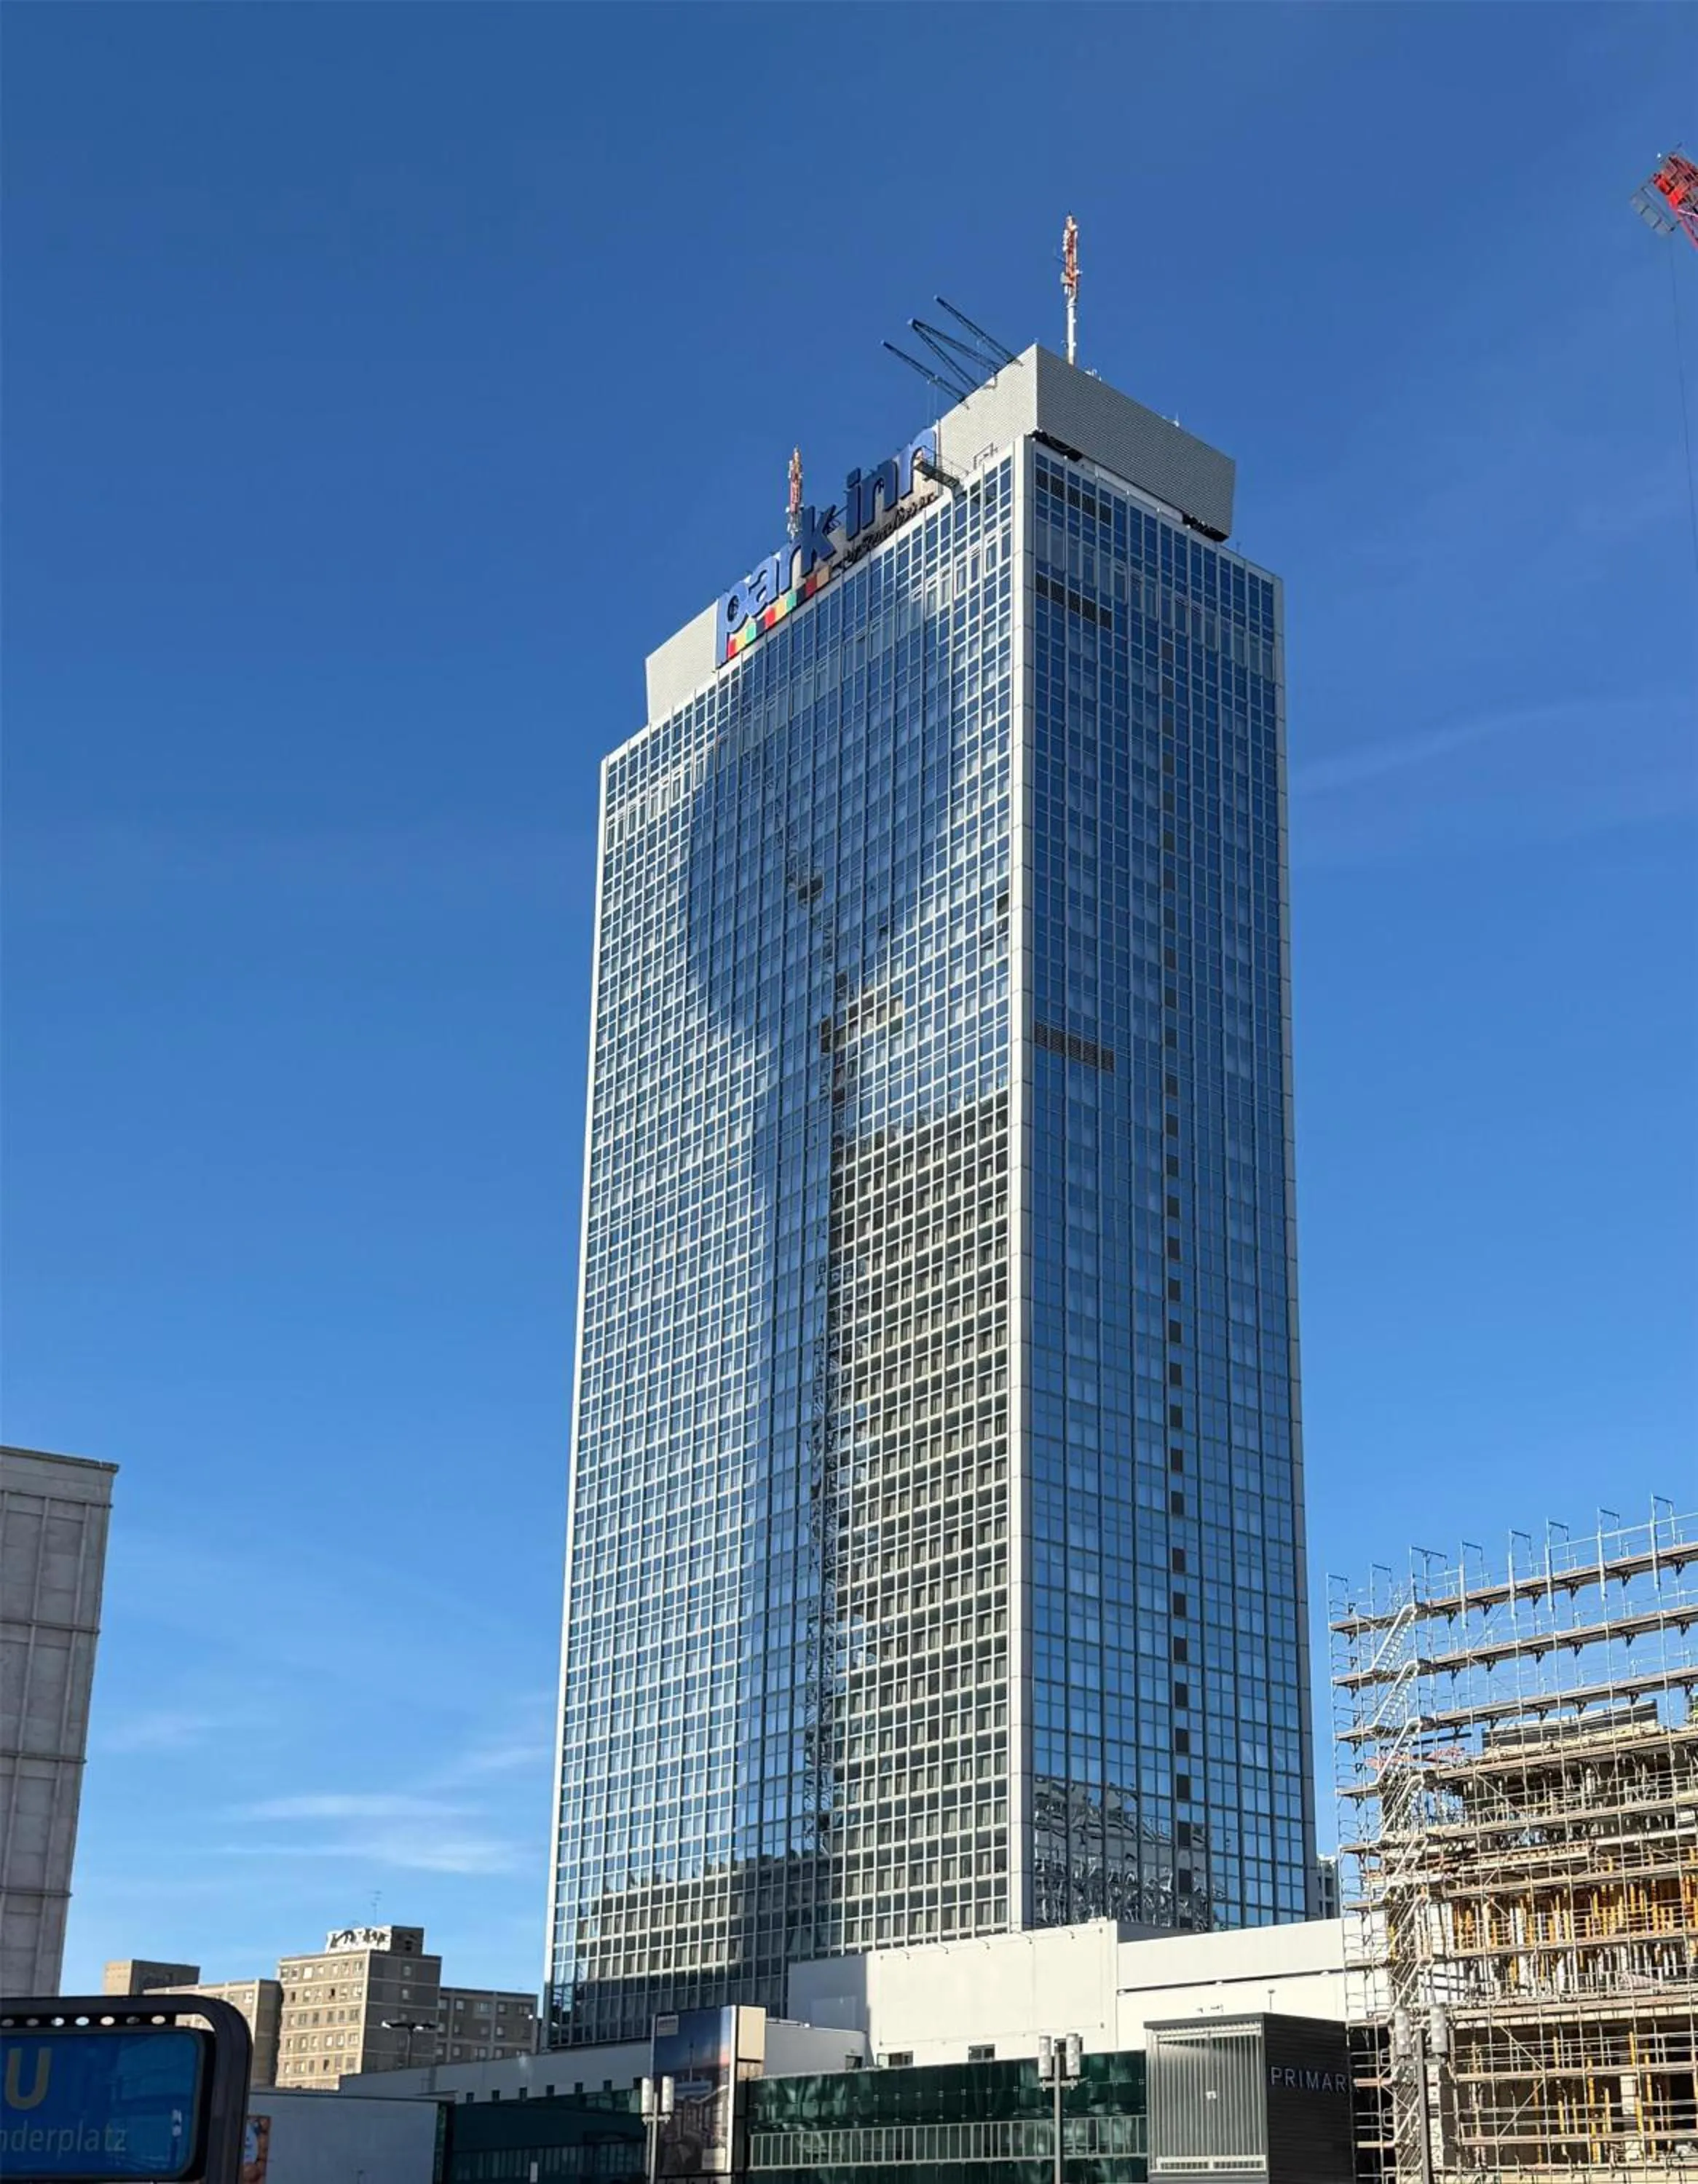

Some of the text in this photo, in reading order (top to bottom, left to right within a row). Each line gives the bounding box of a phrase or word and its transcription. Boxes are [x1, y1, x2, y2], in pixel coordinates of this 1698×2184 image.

[716, 504, 837, 669] park
[845, 427, 936, 541] inn
[5, 2047, 52, 2110] U
[1271, 2066, 1359, 2094] PRIMAR
